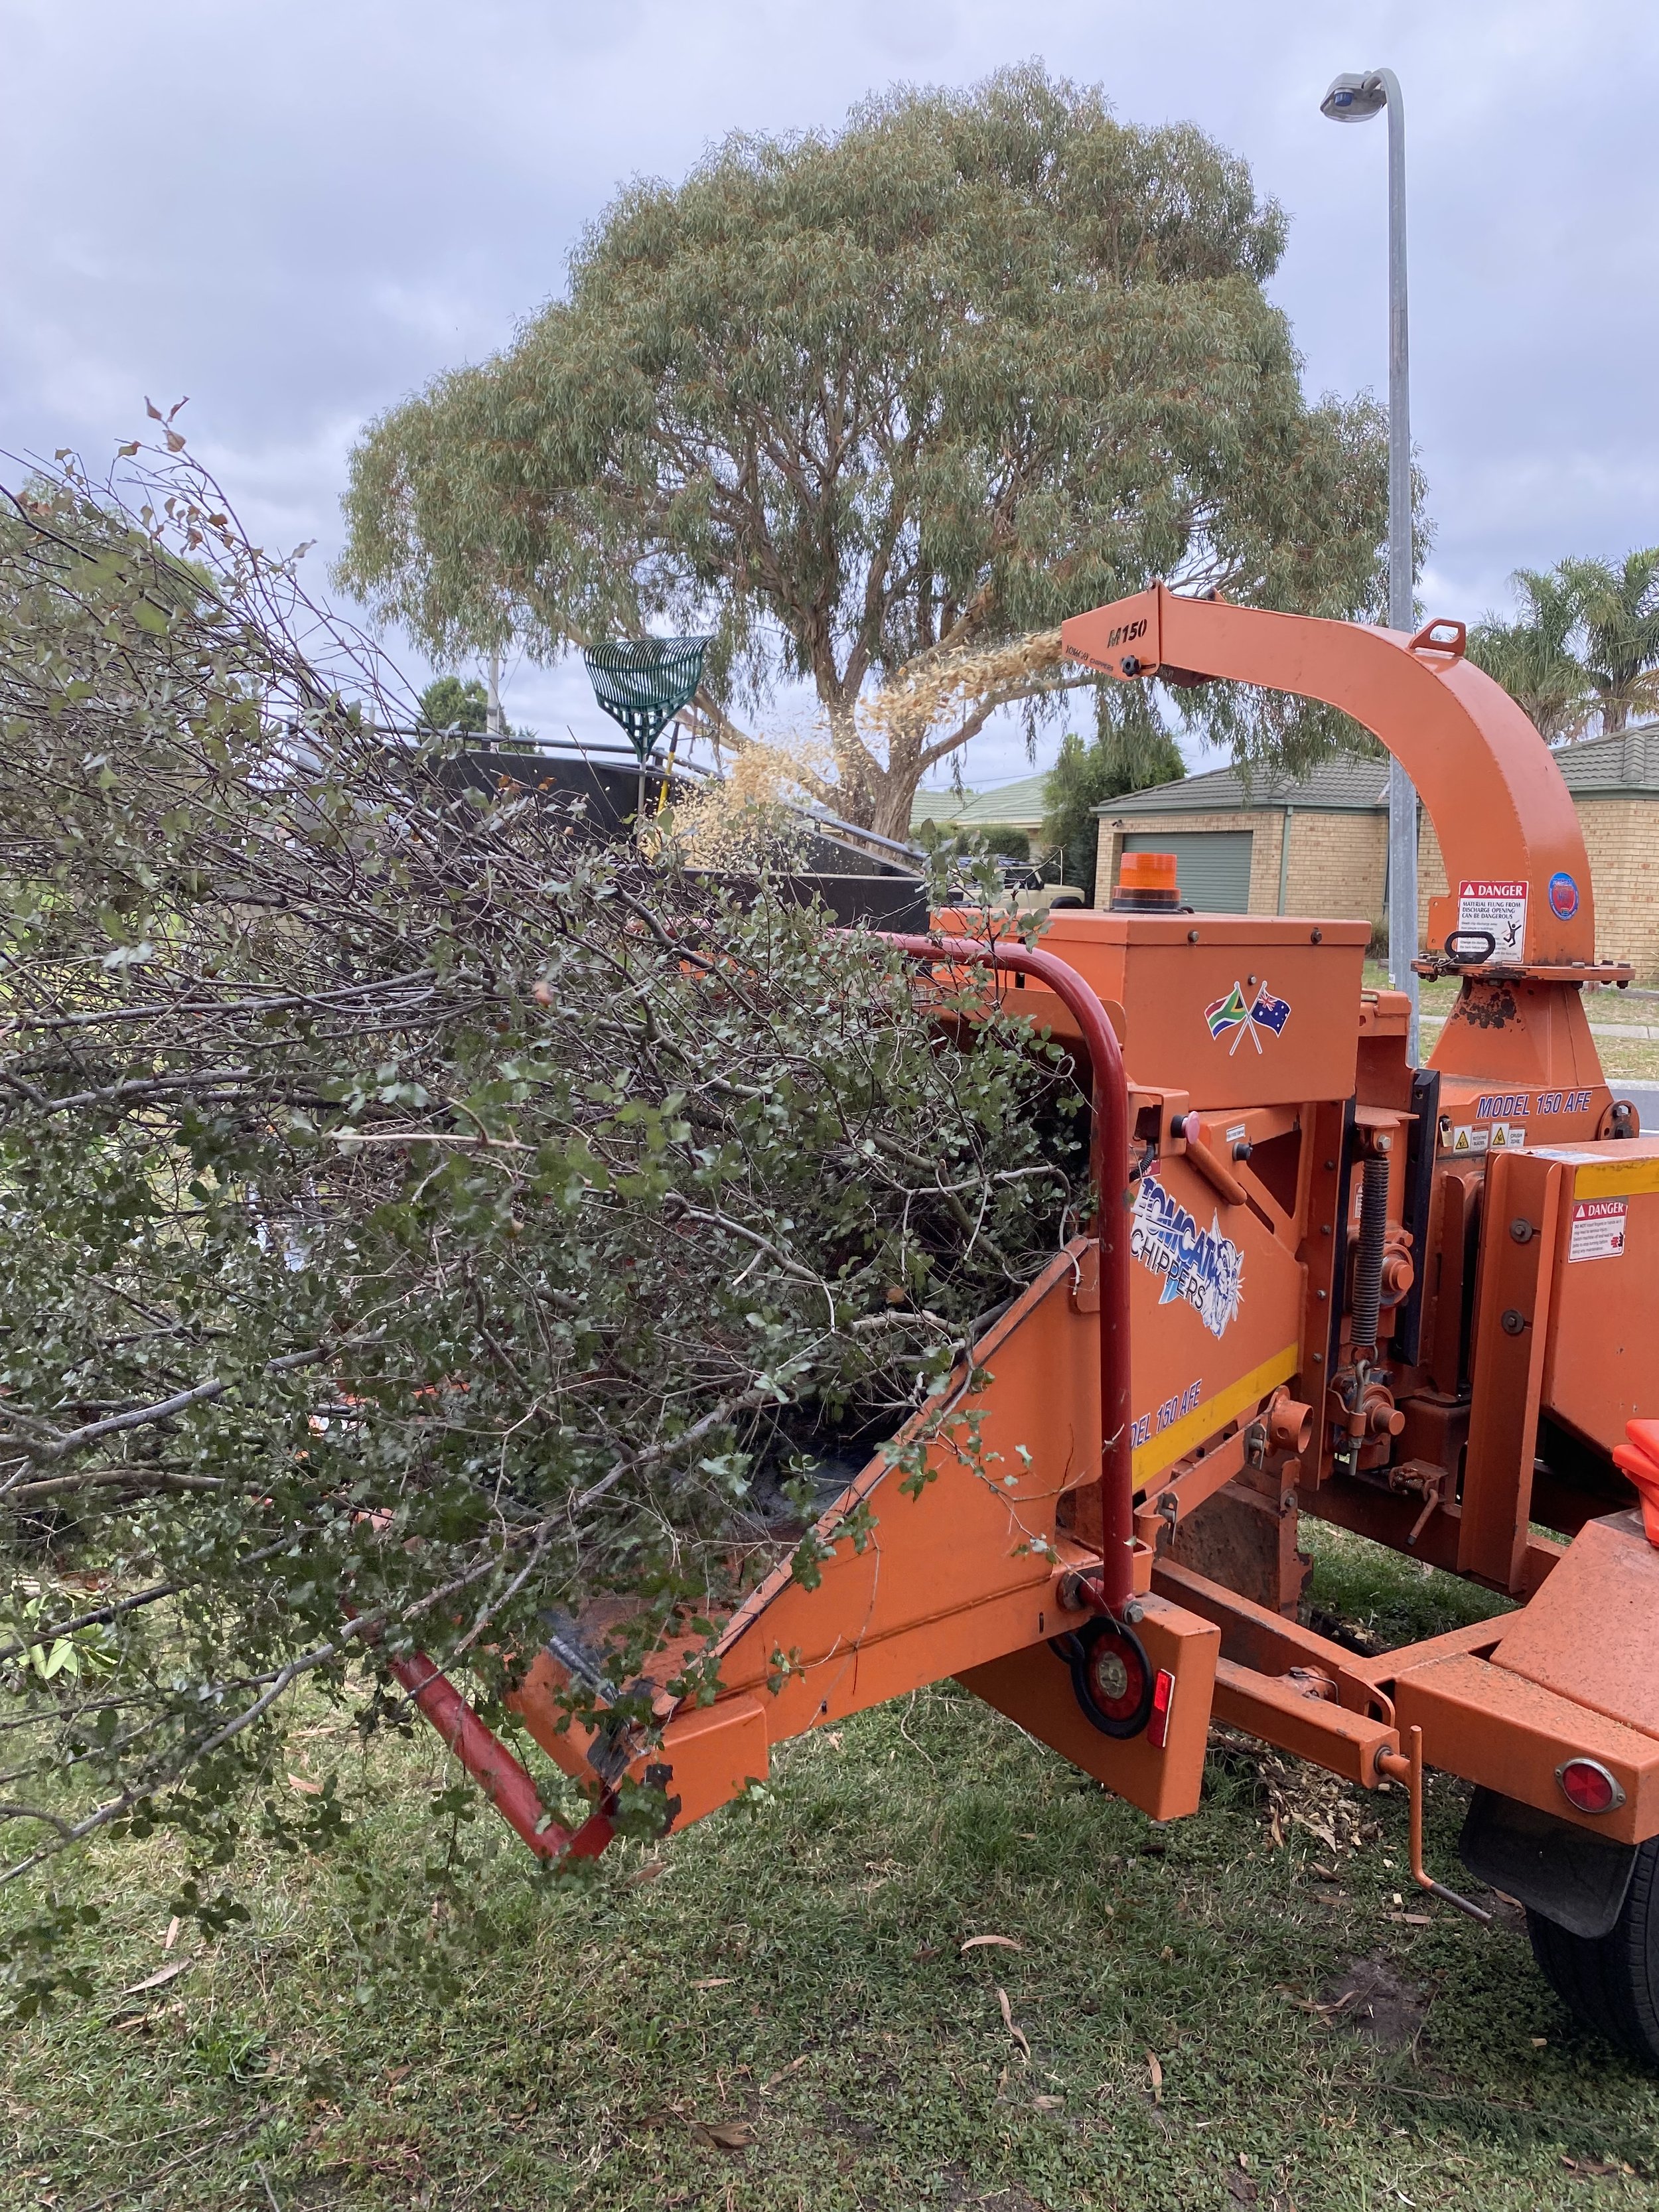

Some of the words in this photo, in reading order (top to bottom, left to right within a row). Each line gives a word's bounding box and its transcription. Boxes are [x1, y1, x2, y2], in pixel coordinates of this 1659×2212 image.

[1107, 619, 1147, 648] M150
[1478, 885, 1523, 896] DANGER
[1476, 1094, 1530, 1120] MODEL
[1536, 1092, 1563, 1116] 150
[1562, 1090, 1593, 1114] AFE
[1588, 1202, 1624, 1217] DANGER
[1132, 1177, 1216, 1278] TOMCAT
[1131, 1228, 1206, 1311] CHIPPERS
[1130, 1412, 1151, 1451] DEL
[1156, 1395, 1179, 1434] 150
[1177, 1378, 1202, 1420] AFE
